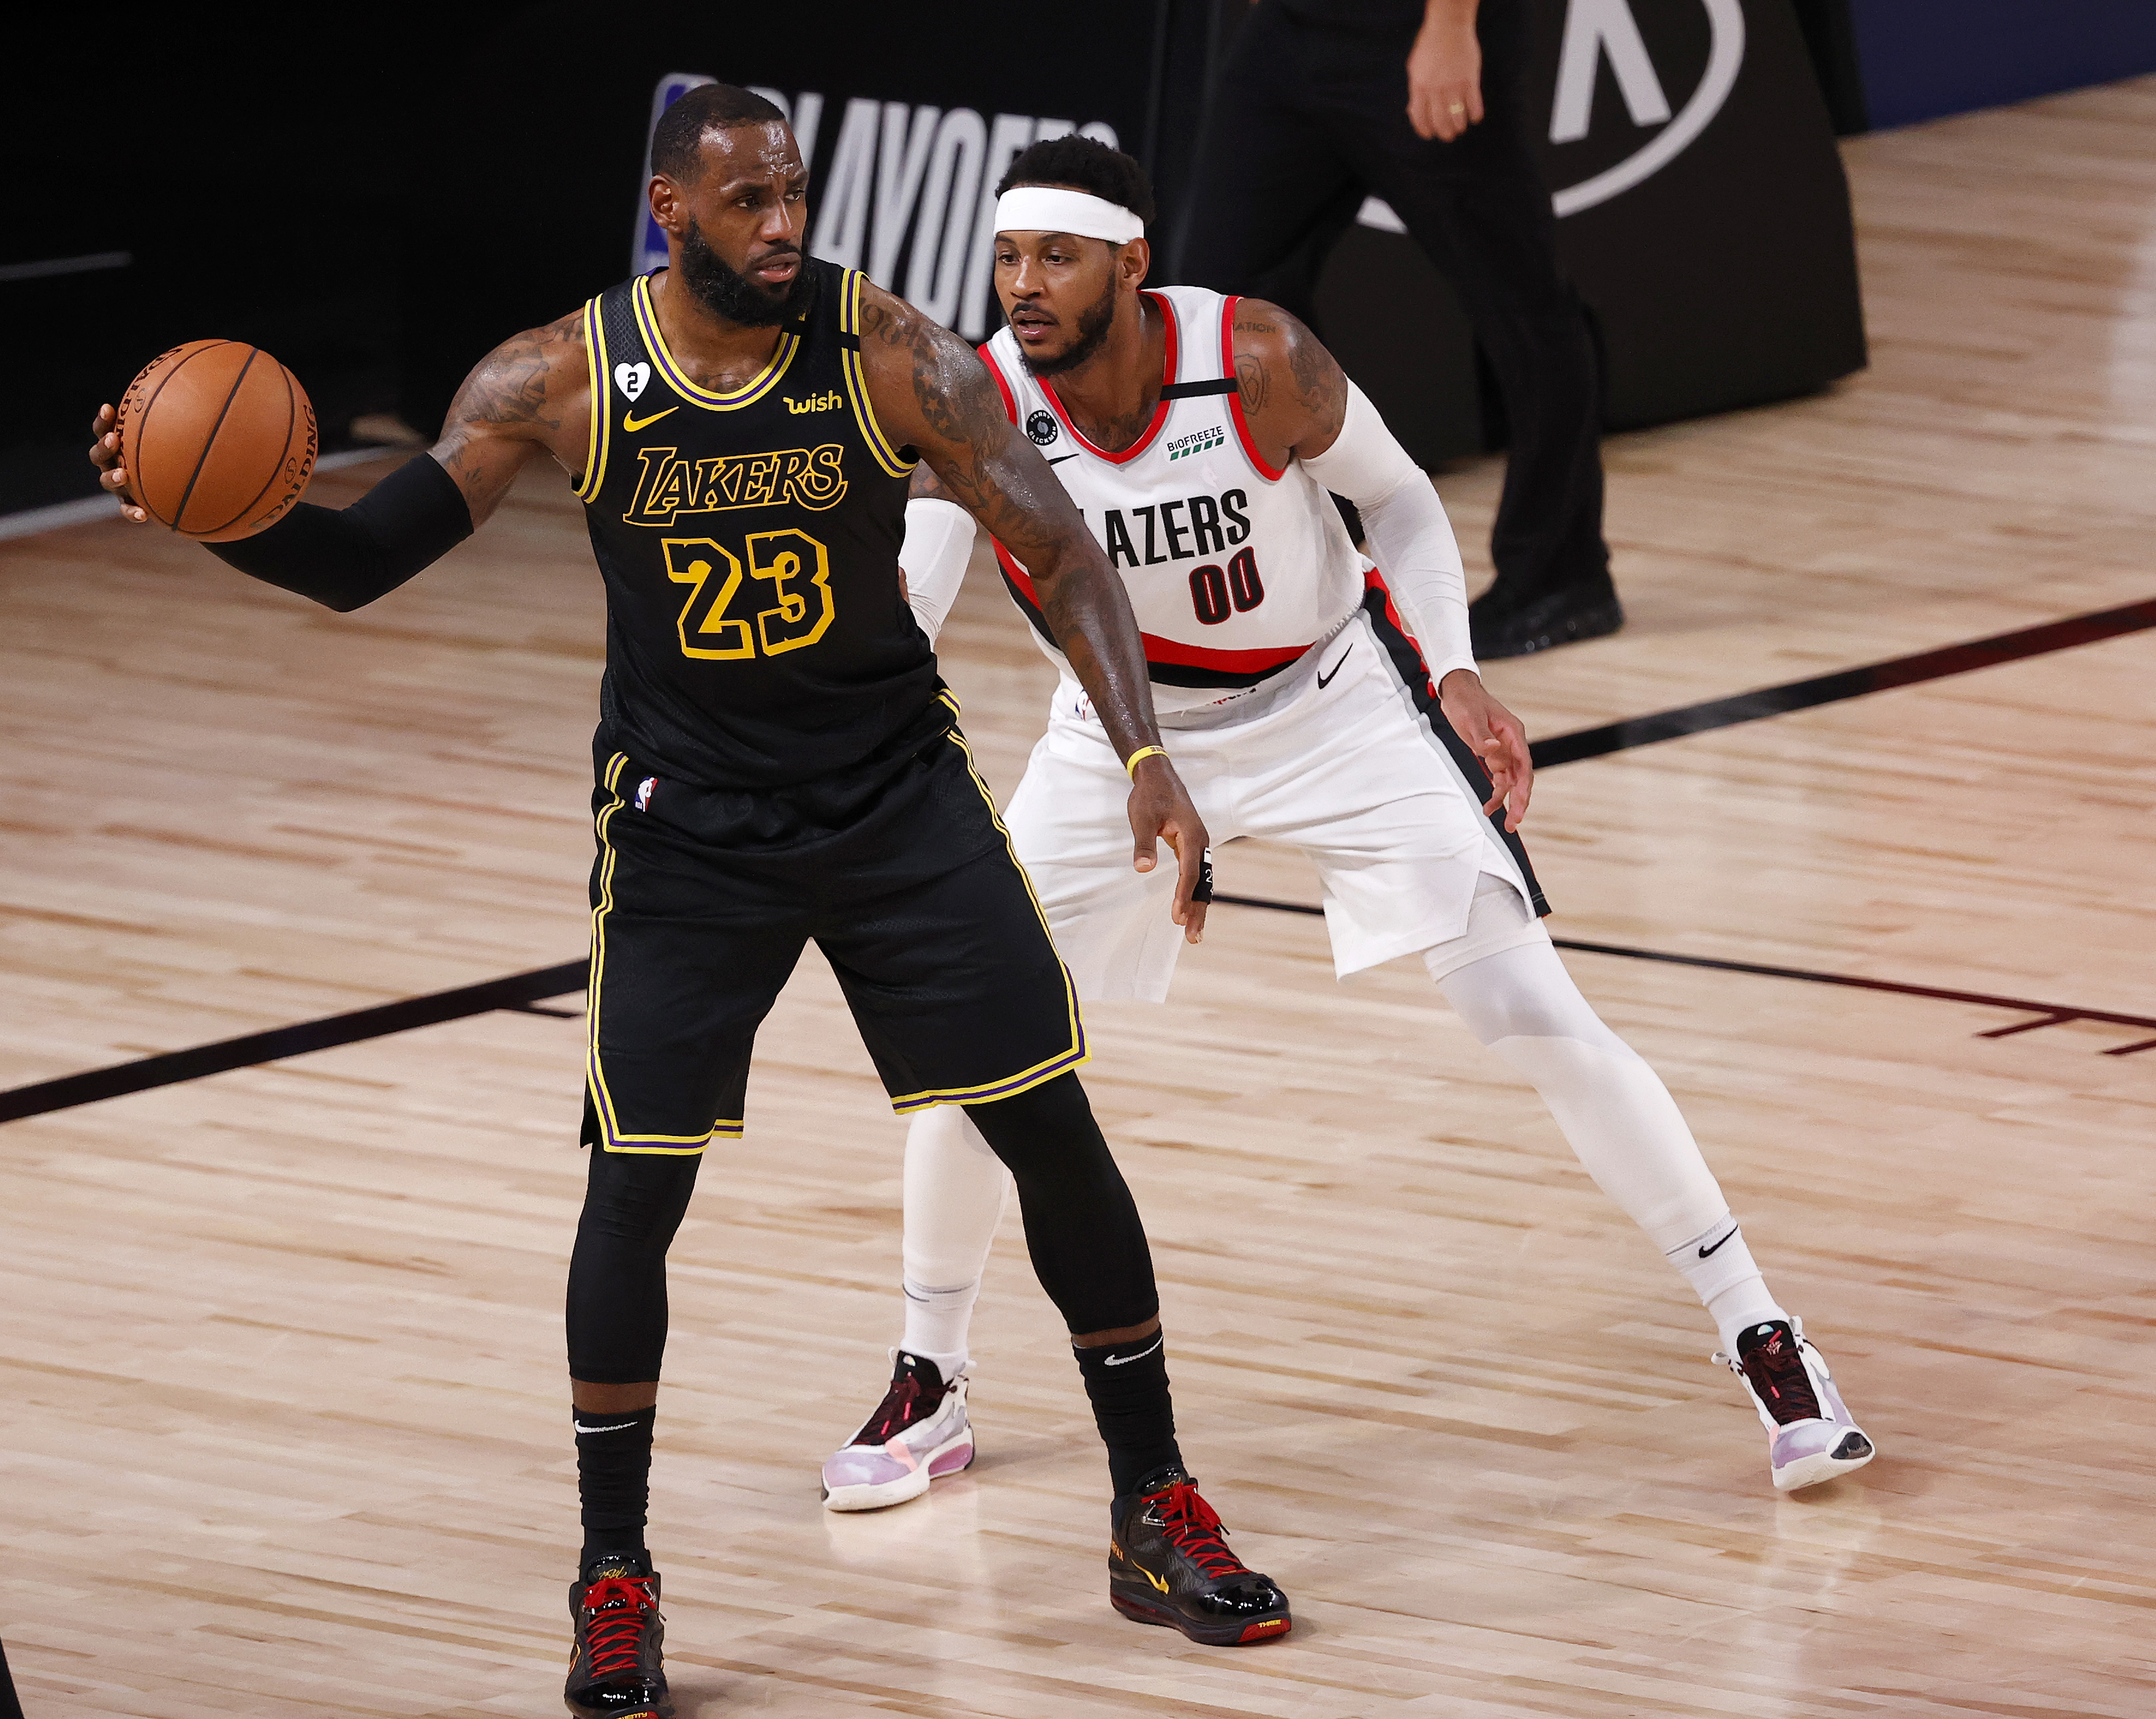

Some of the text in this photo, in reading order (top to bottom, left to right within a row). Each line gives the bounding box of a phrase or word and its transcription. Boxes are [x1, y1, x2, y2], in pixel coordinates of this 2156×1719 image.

[744, 85, 1121, 341] AYOF
[860, 298, 922, 347] 984
[1235, 322, 1276, 333] ATION
[627, 372, 638, 393] 2
[783, 390, 842, 415] wish
[1028, 426, 1056, 444] GLICKMAN
[1030, 412, 1050, 423] HARRY
[623, 444, 848, 527] LAKERS
[1078, 489, 1251, 569] AZERS
[661, 528, 835, 660] 23
[1189, 546, 1265, 625] 00
